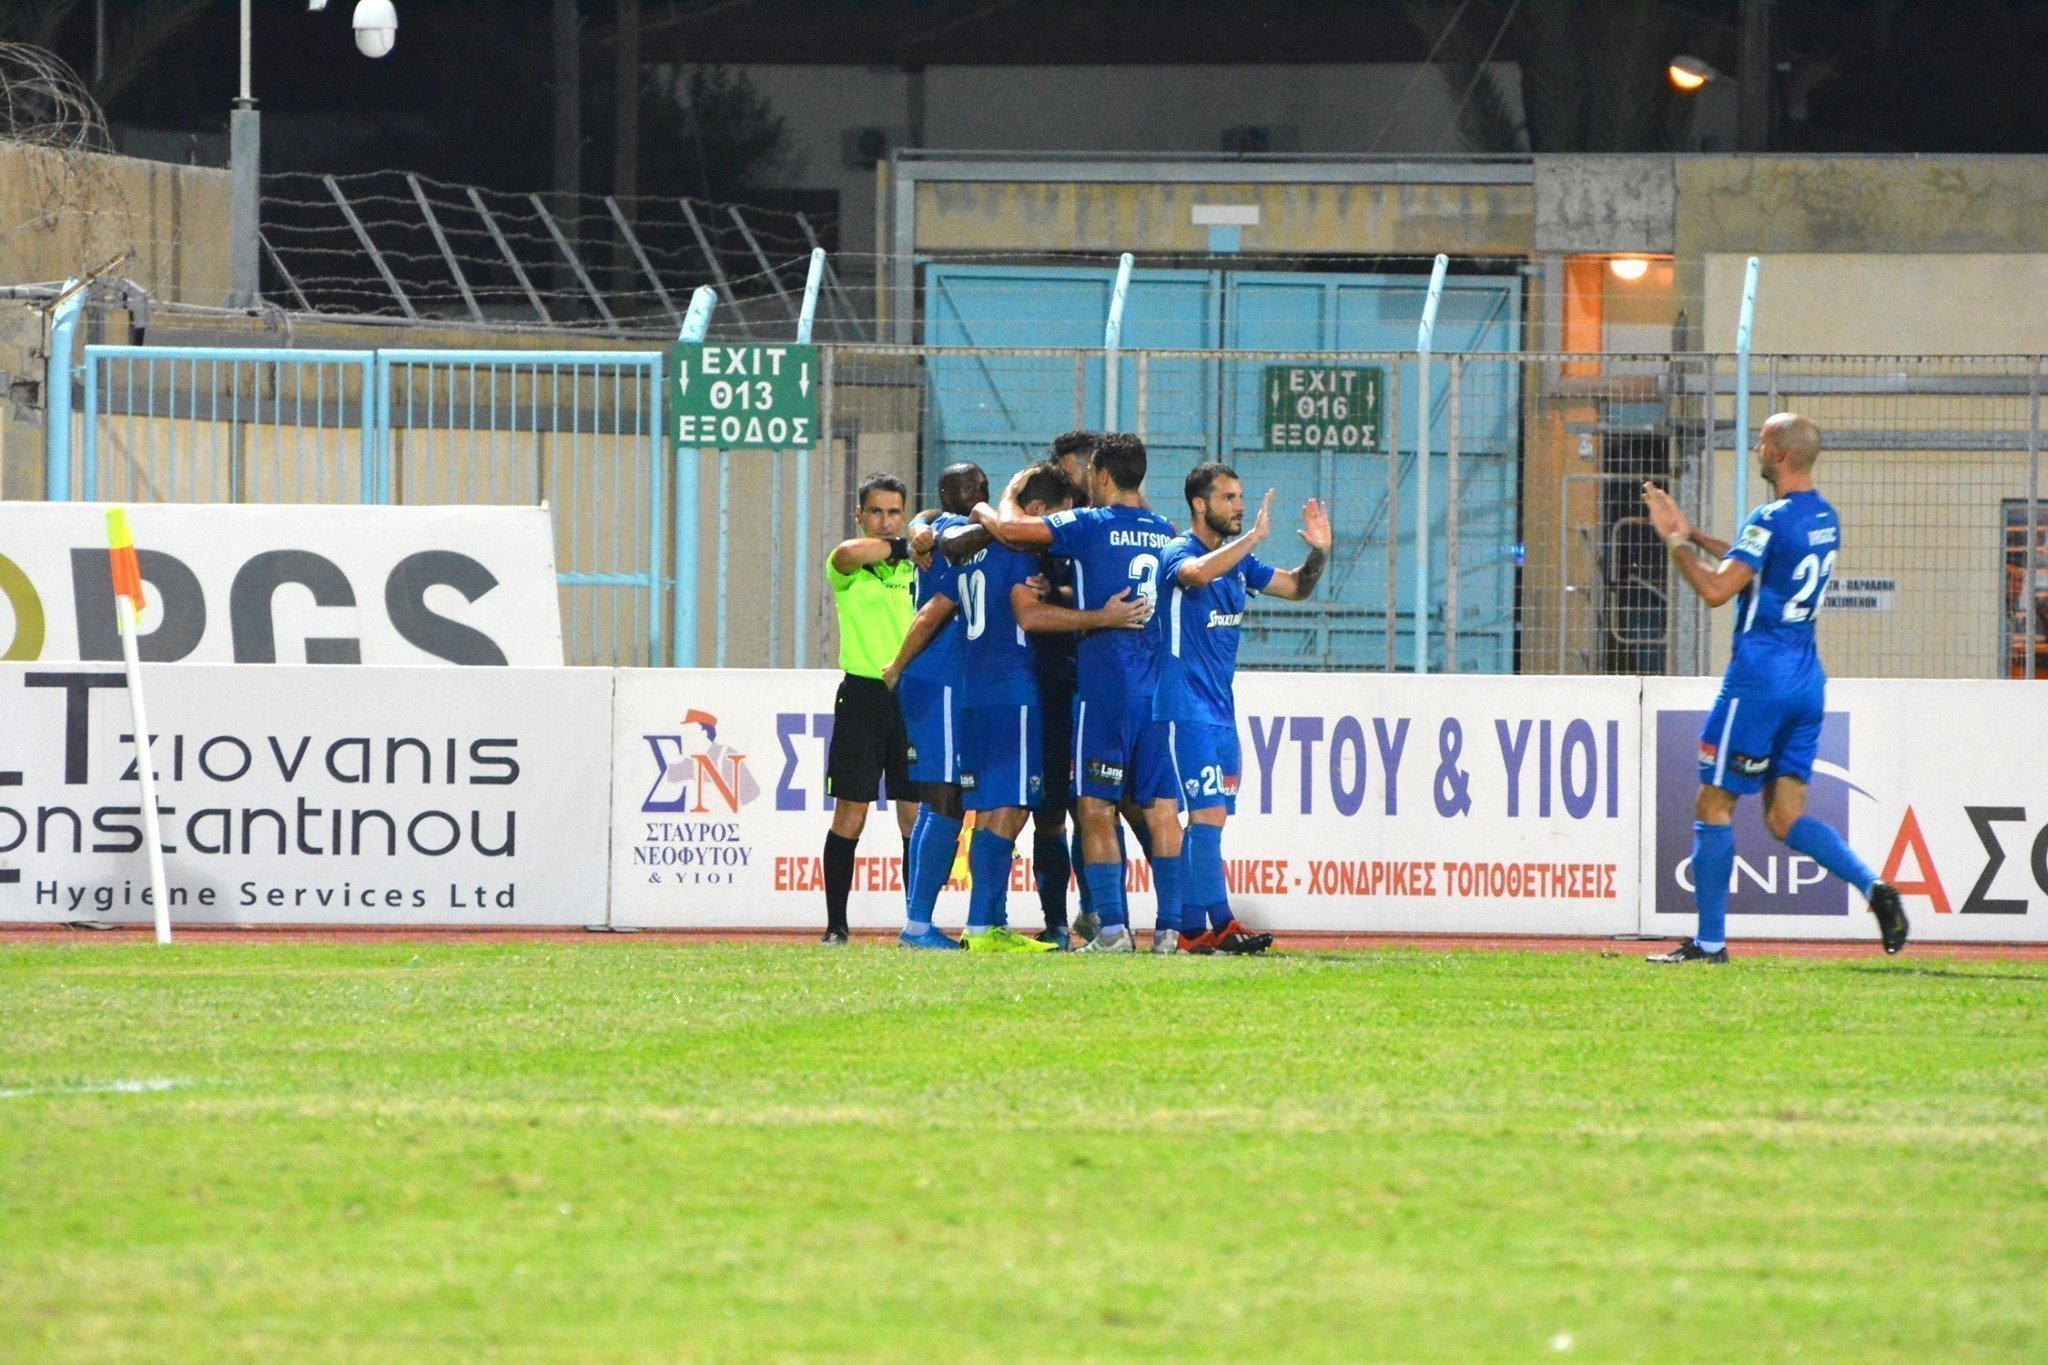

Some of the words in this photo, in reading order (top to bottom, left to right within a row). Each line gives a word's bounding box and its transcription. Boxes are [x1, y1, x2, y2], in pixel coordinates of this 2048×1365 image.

[702, 347, 787, 375] EXIT
[1289, 369, 1357, 394] EXIT
[679, 415, 809, 444] ΕΞΟΔΟΣ
[1271, 423, 1376, 446] ΕΞΟΔΟΣ
[1128, 553, 1159, 624] 3
[1243, 715, 1411, 817] ΥΤΟΥ
[1433, 716, 1472, 819] &
[1495, 718, 1619, 820] ΥΙΟΙ
[645, 823, 740, 843] ΣΤΑΥΡΟΣ
[633, 846, 752, 868] ΝΕΟΦΥΤΟΥ
[648, 872, 662, 884] &
[774, 857, 901, 891] ΕΙΣΑΓΕΙΣ
[1308, 861, 1436, 897] ΧΟΝΔΡΙΚΕΣ
[1443, 862, 1616, 899] ΤΟΠΟΘΕΤΗΣΕΙΣ
[36, 880, 216, 911] Hygiene
[240, 881, 426, 907] Services
[450, 883, 515, 908] Ltd
